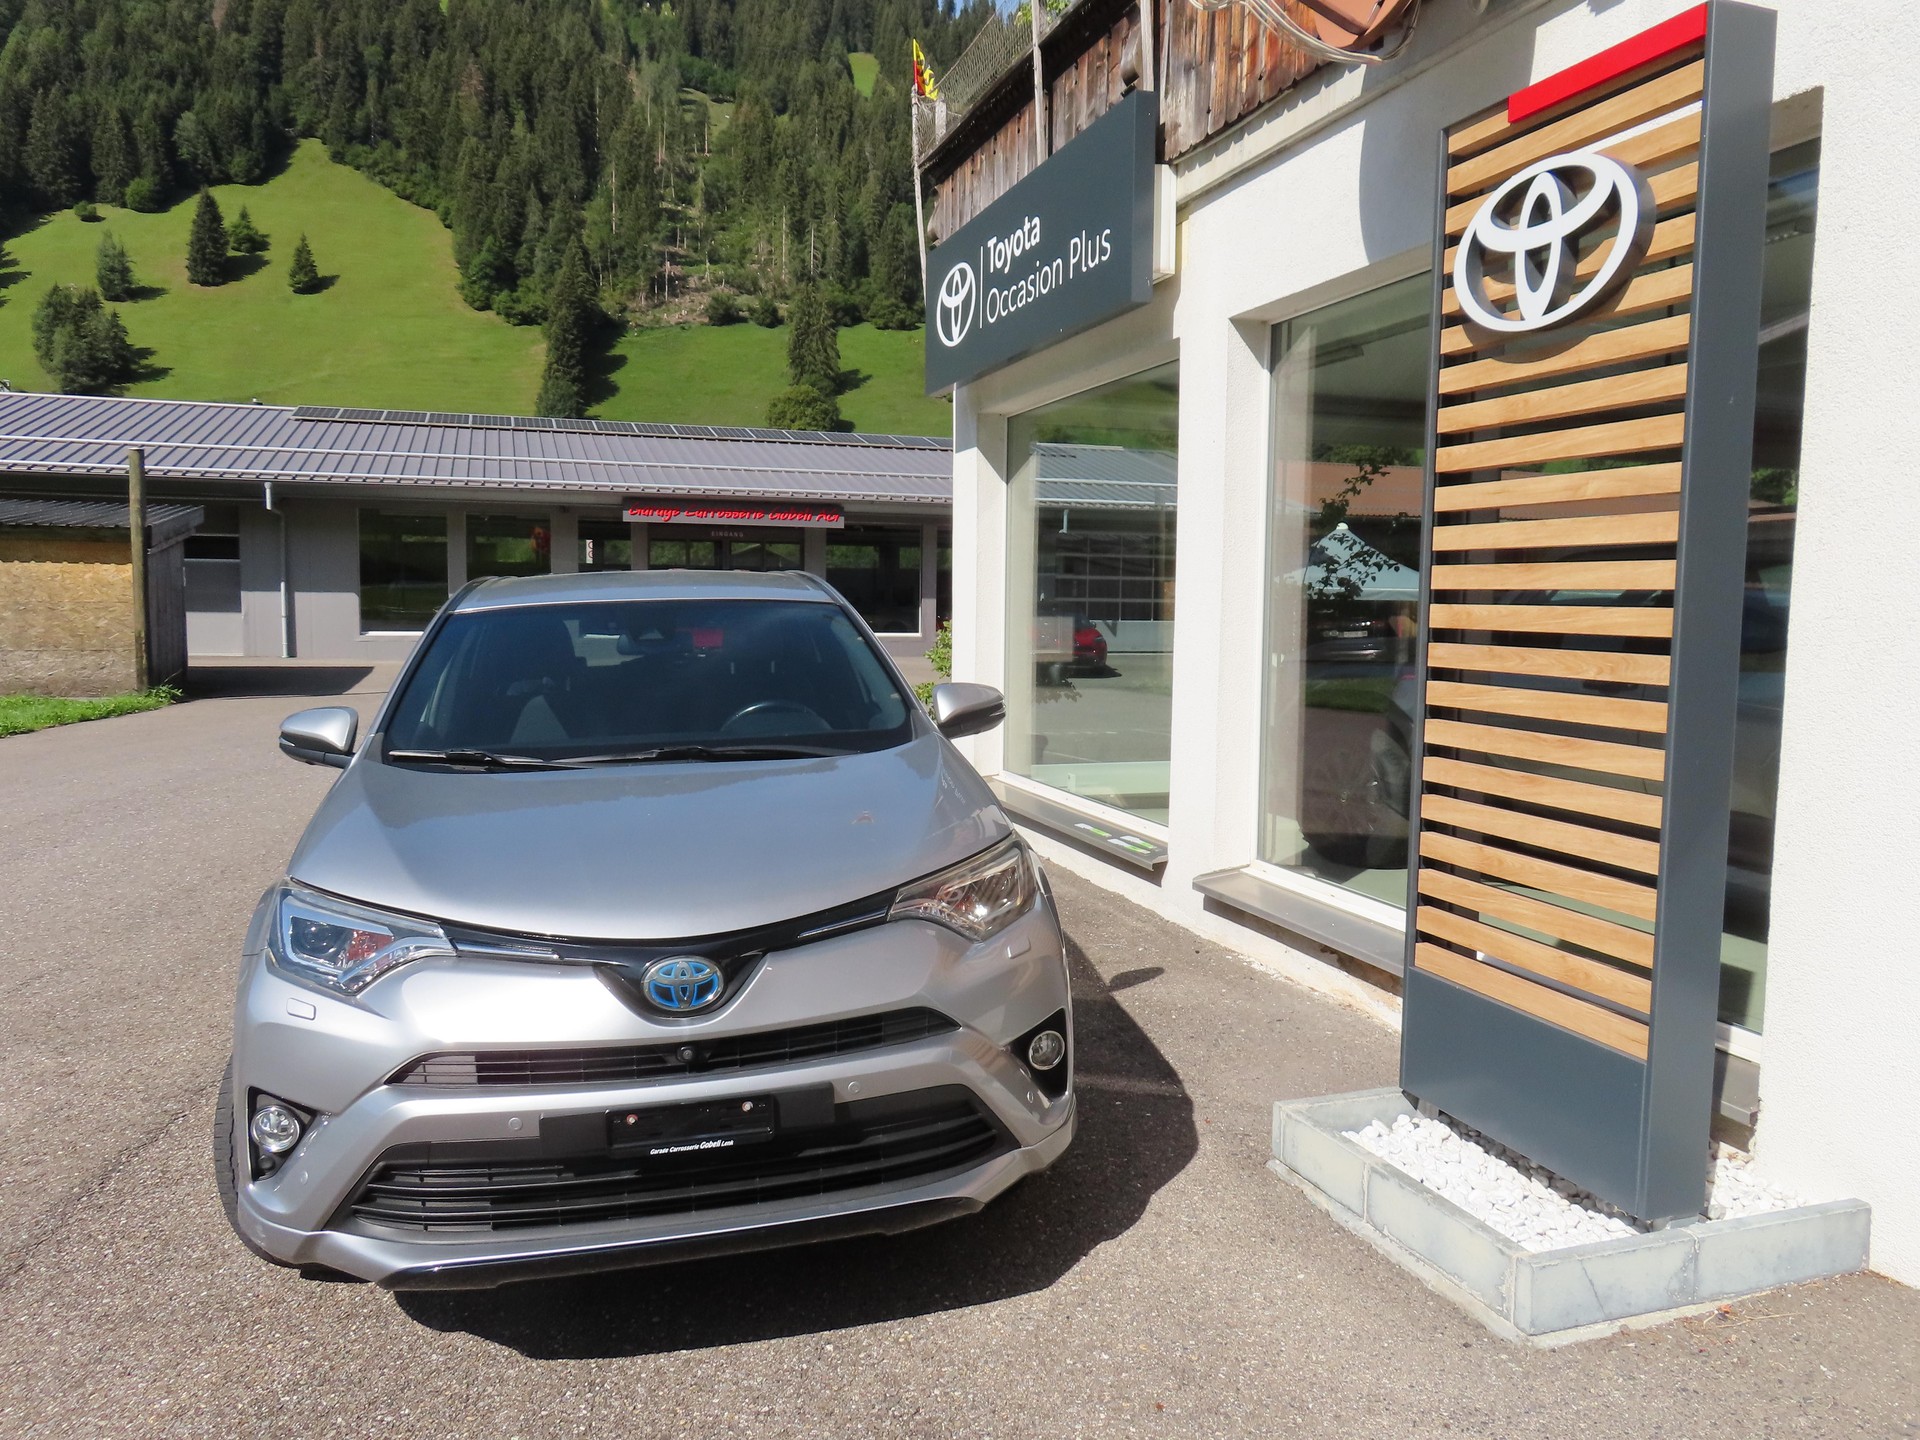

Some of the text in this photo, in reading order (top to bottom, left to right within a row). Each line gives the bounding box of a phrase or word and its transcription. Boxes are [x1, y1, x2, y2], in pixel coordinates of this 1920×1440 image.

[987, 215, 1040, 273] Toyota
[986, 229, 1111, 324] Occasion Plus
[711, 530, 744, 538] EINGANG
[721, 1139, 734, 1147] Lenk
